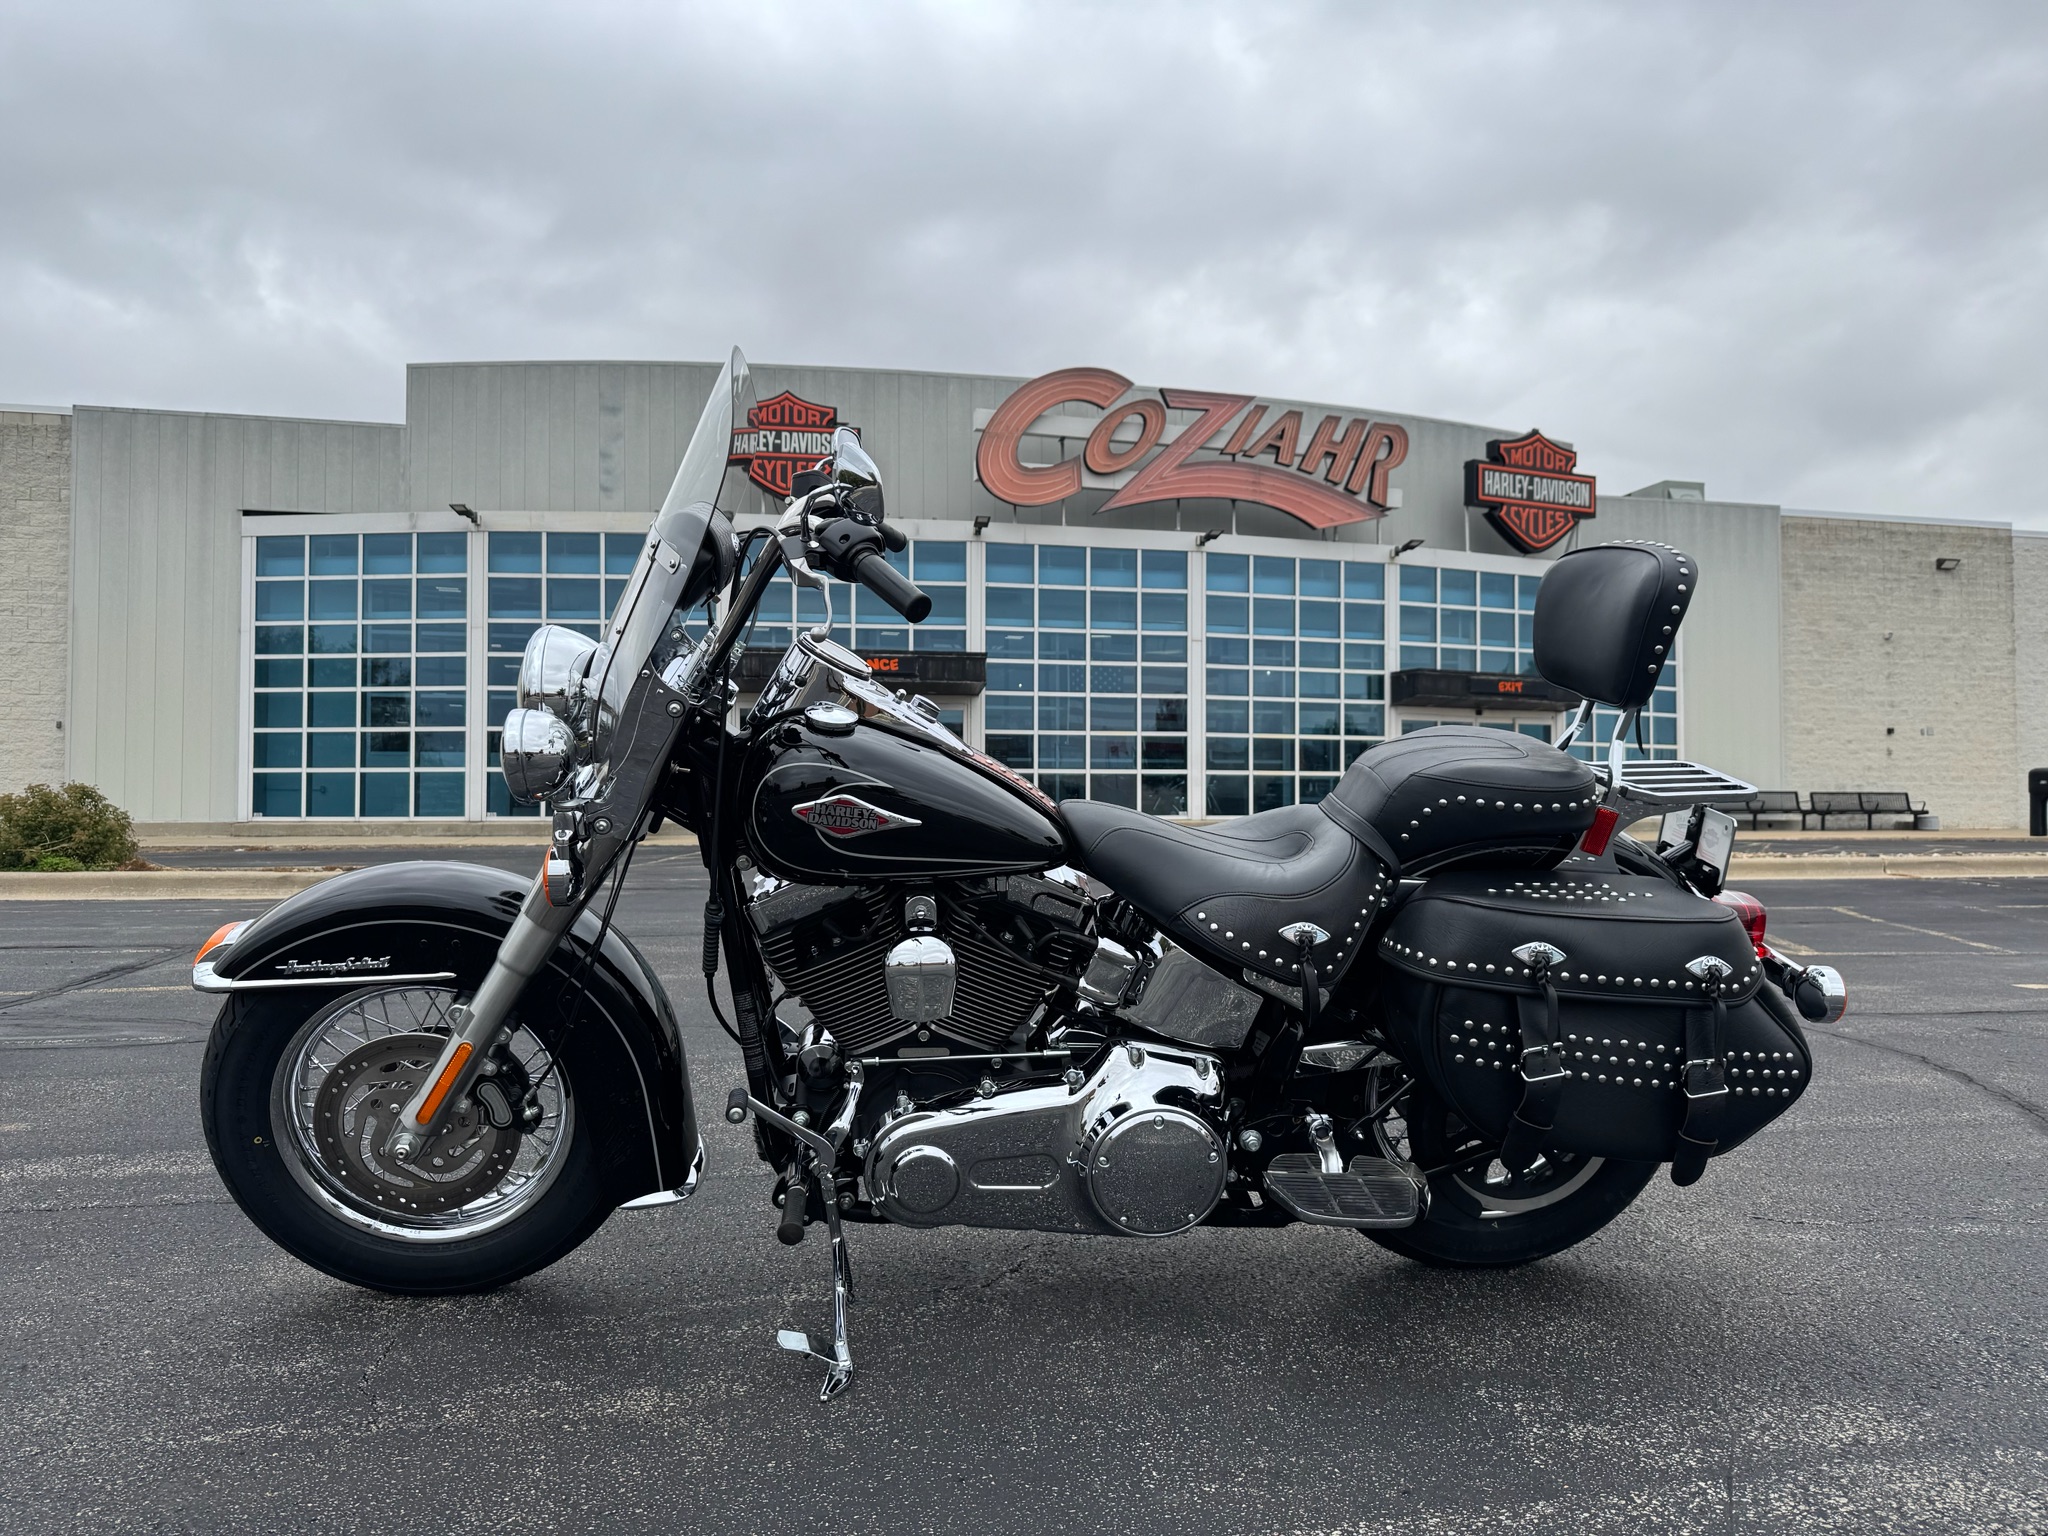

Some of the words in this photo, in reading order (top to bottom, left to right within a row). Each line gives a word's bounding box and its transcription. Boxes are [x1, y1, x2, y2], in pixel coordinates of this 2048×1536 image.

[757, 400, 821, 426] MOTOR
[976, 366, 1410, 530] COZIAHR
[1510, 441, 1566, 472] MOTOR
[1484, 470, 1590, 507] HARLEY-DAVIDSON
[1510, 507, 1564, 539] CYCLES
[1498, 681, 1523, 693] EXIT
[807, 812, 878, 830] DAVIDSON
